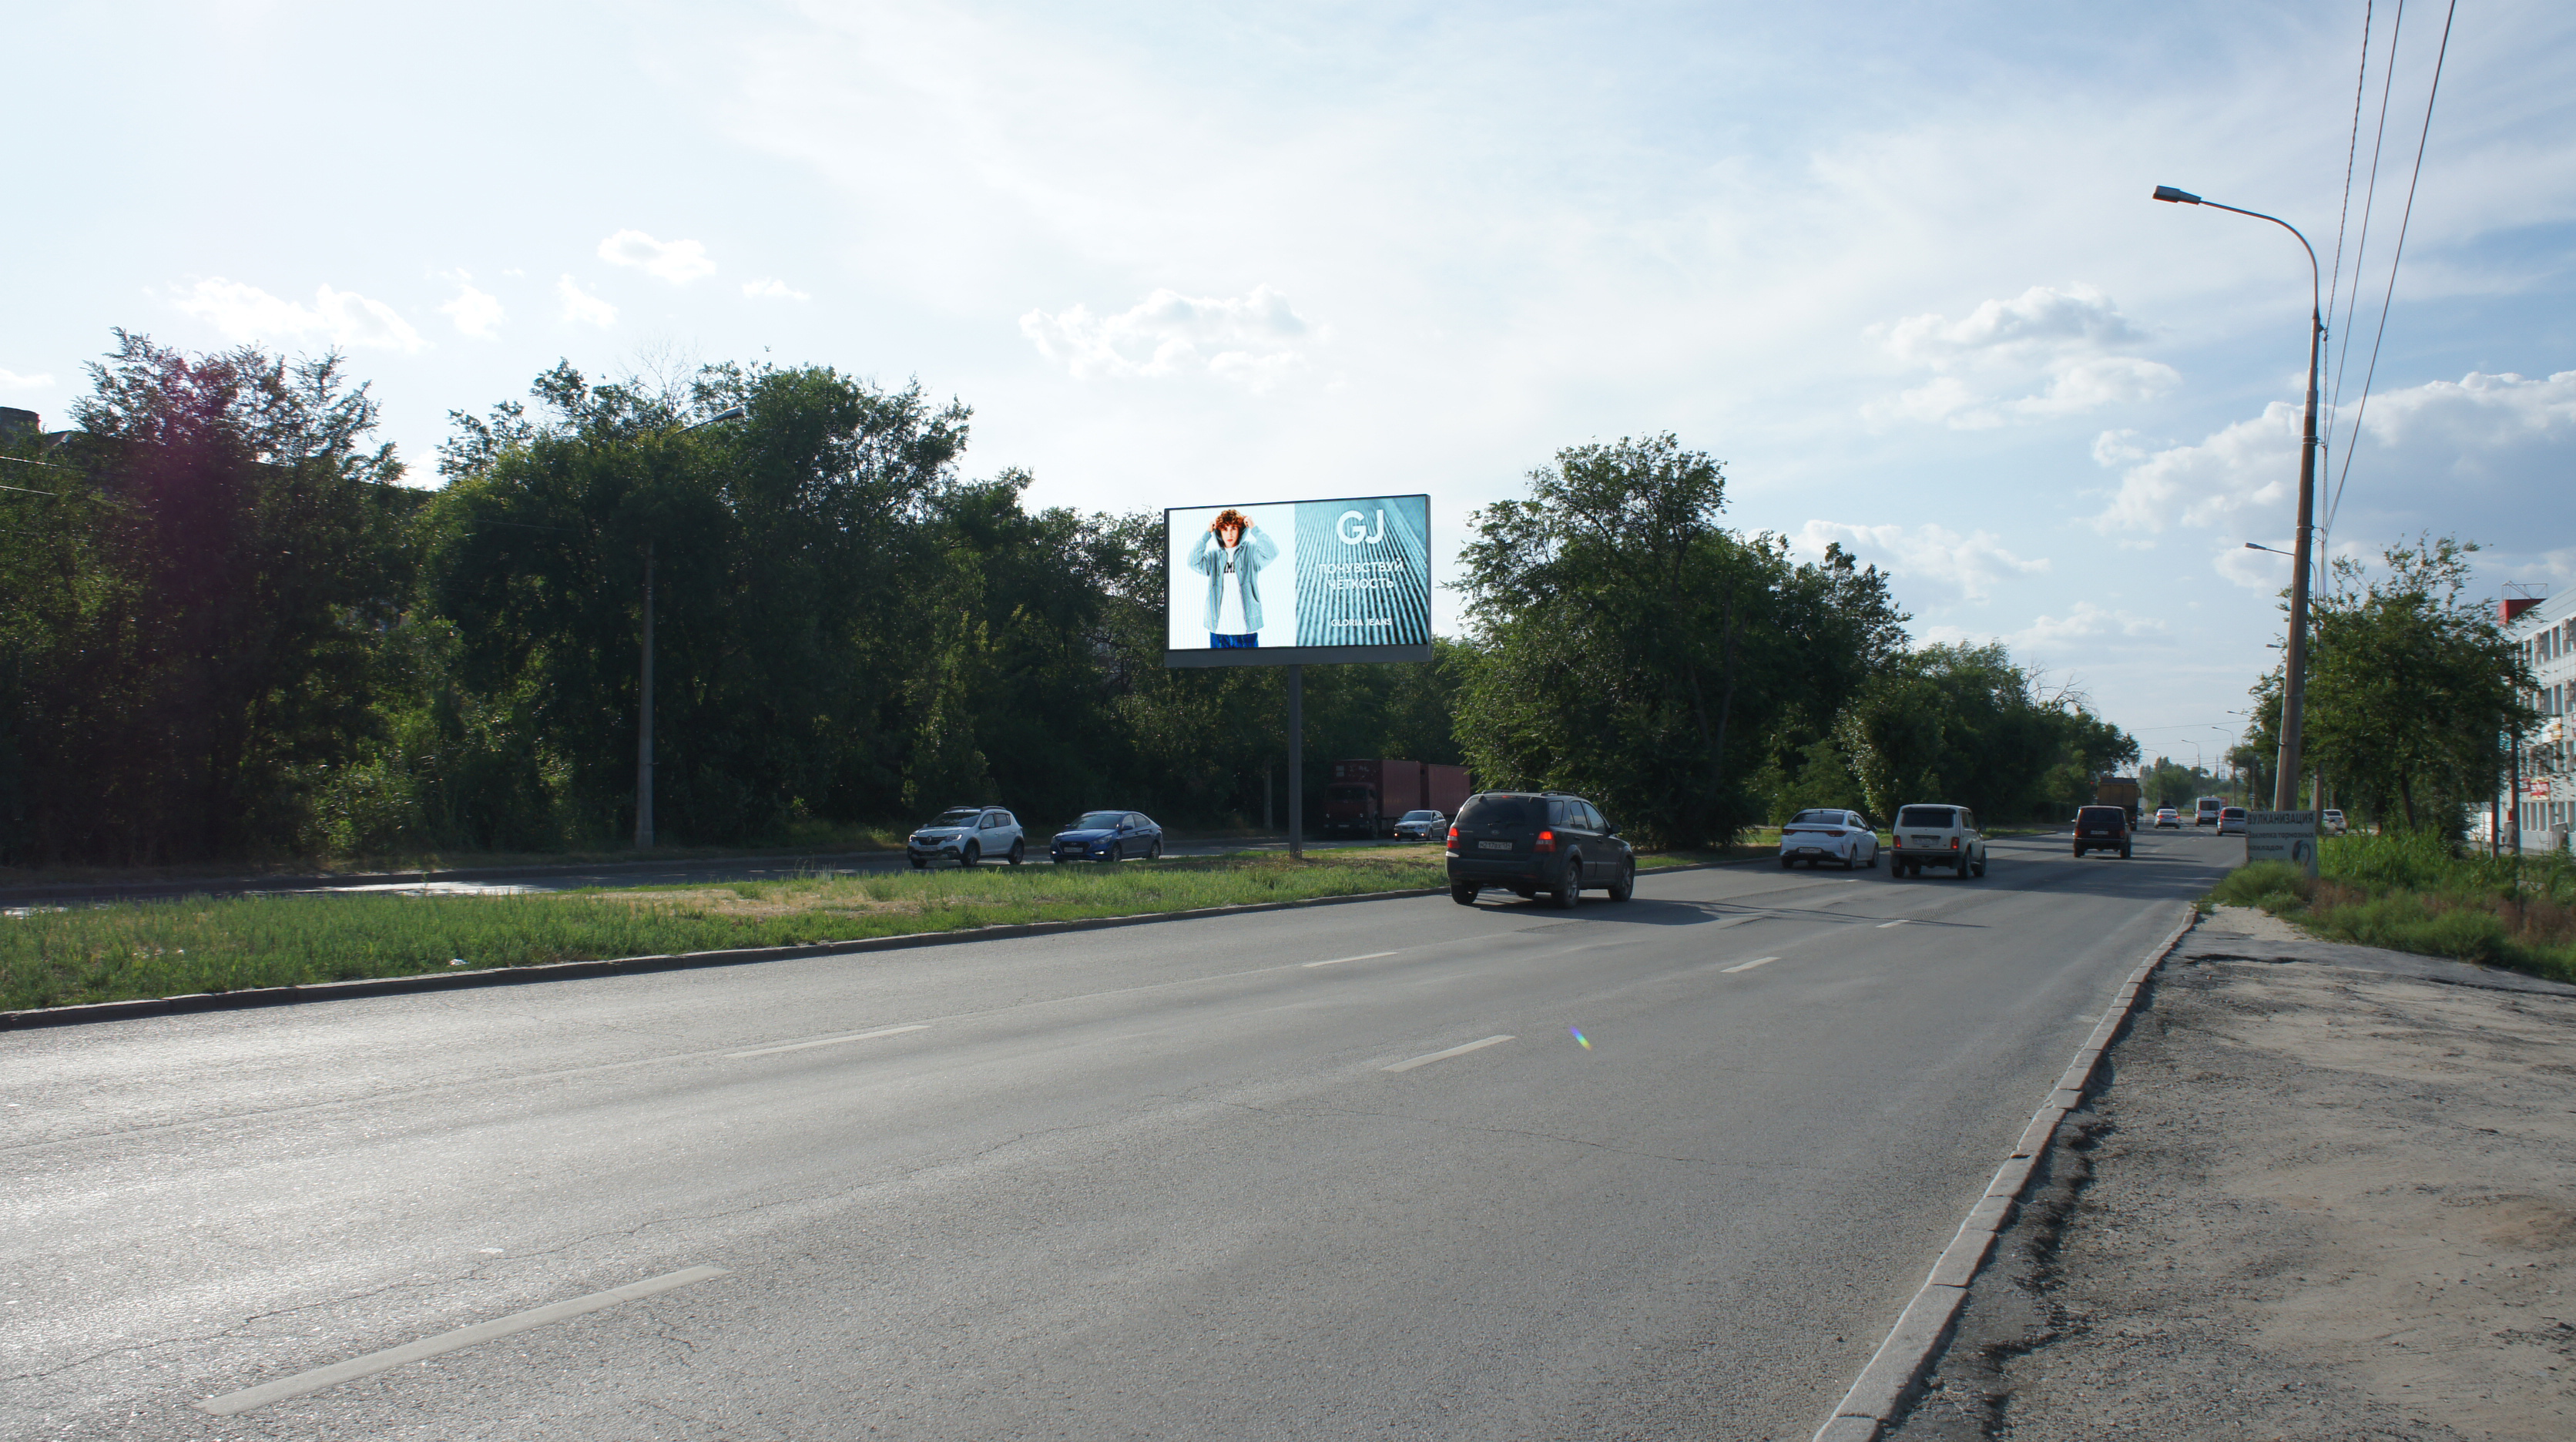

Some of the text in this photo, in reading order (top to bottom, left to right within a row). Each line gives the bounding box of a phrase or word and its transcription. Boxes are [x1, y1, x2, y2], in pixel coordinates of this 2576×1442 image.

[1337, 509, 1385, 545] GJ
[1318, 558, 1404, 574] ПОЧУВСТВУЙ
[1327, 576, 1394, 590] ЧЁТКОСТЬ
[1330, 618, 1393, 627] GLORIA JEANS
[2247, 813, 2313, 826] ВУЛКАНИЗАЦИЯ
[2278, 832, 2313, 840] тормозных
